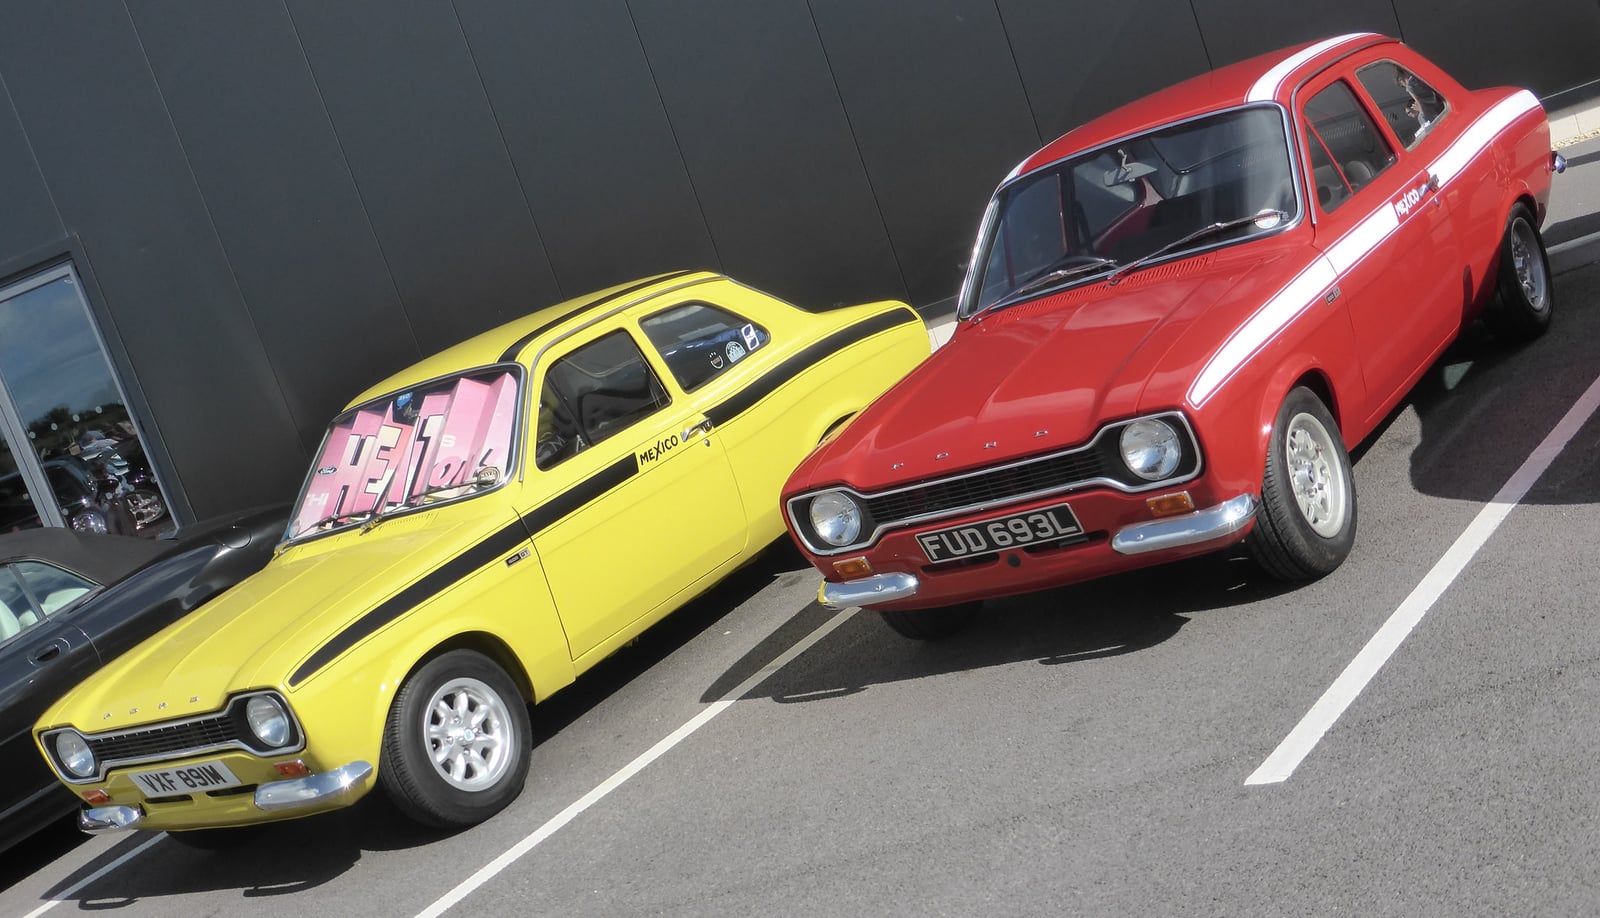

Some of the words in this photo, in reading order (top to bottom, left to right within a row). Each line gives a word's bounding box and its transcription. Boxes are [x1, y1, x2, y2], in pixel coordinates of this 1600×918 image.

[1394, 188, 1420, 217] MEXICO
[639, 434, 679, 466] MEXICO
[920, 527, 988, 560] FUD
[986, 511, 1078, 546] 693L
[138, 772, 177, 793] VXF
[175, 764, 228, 789] 891M
